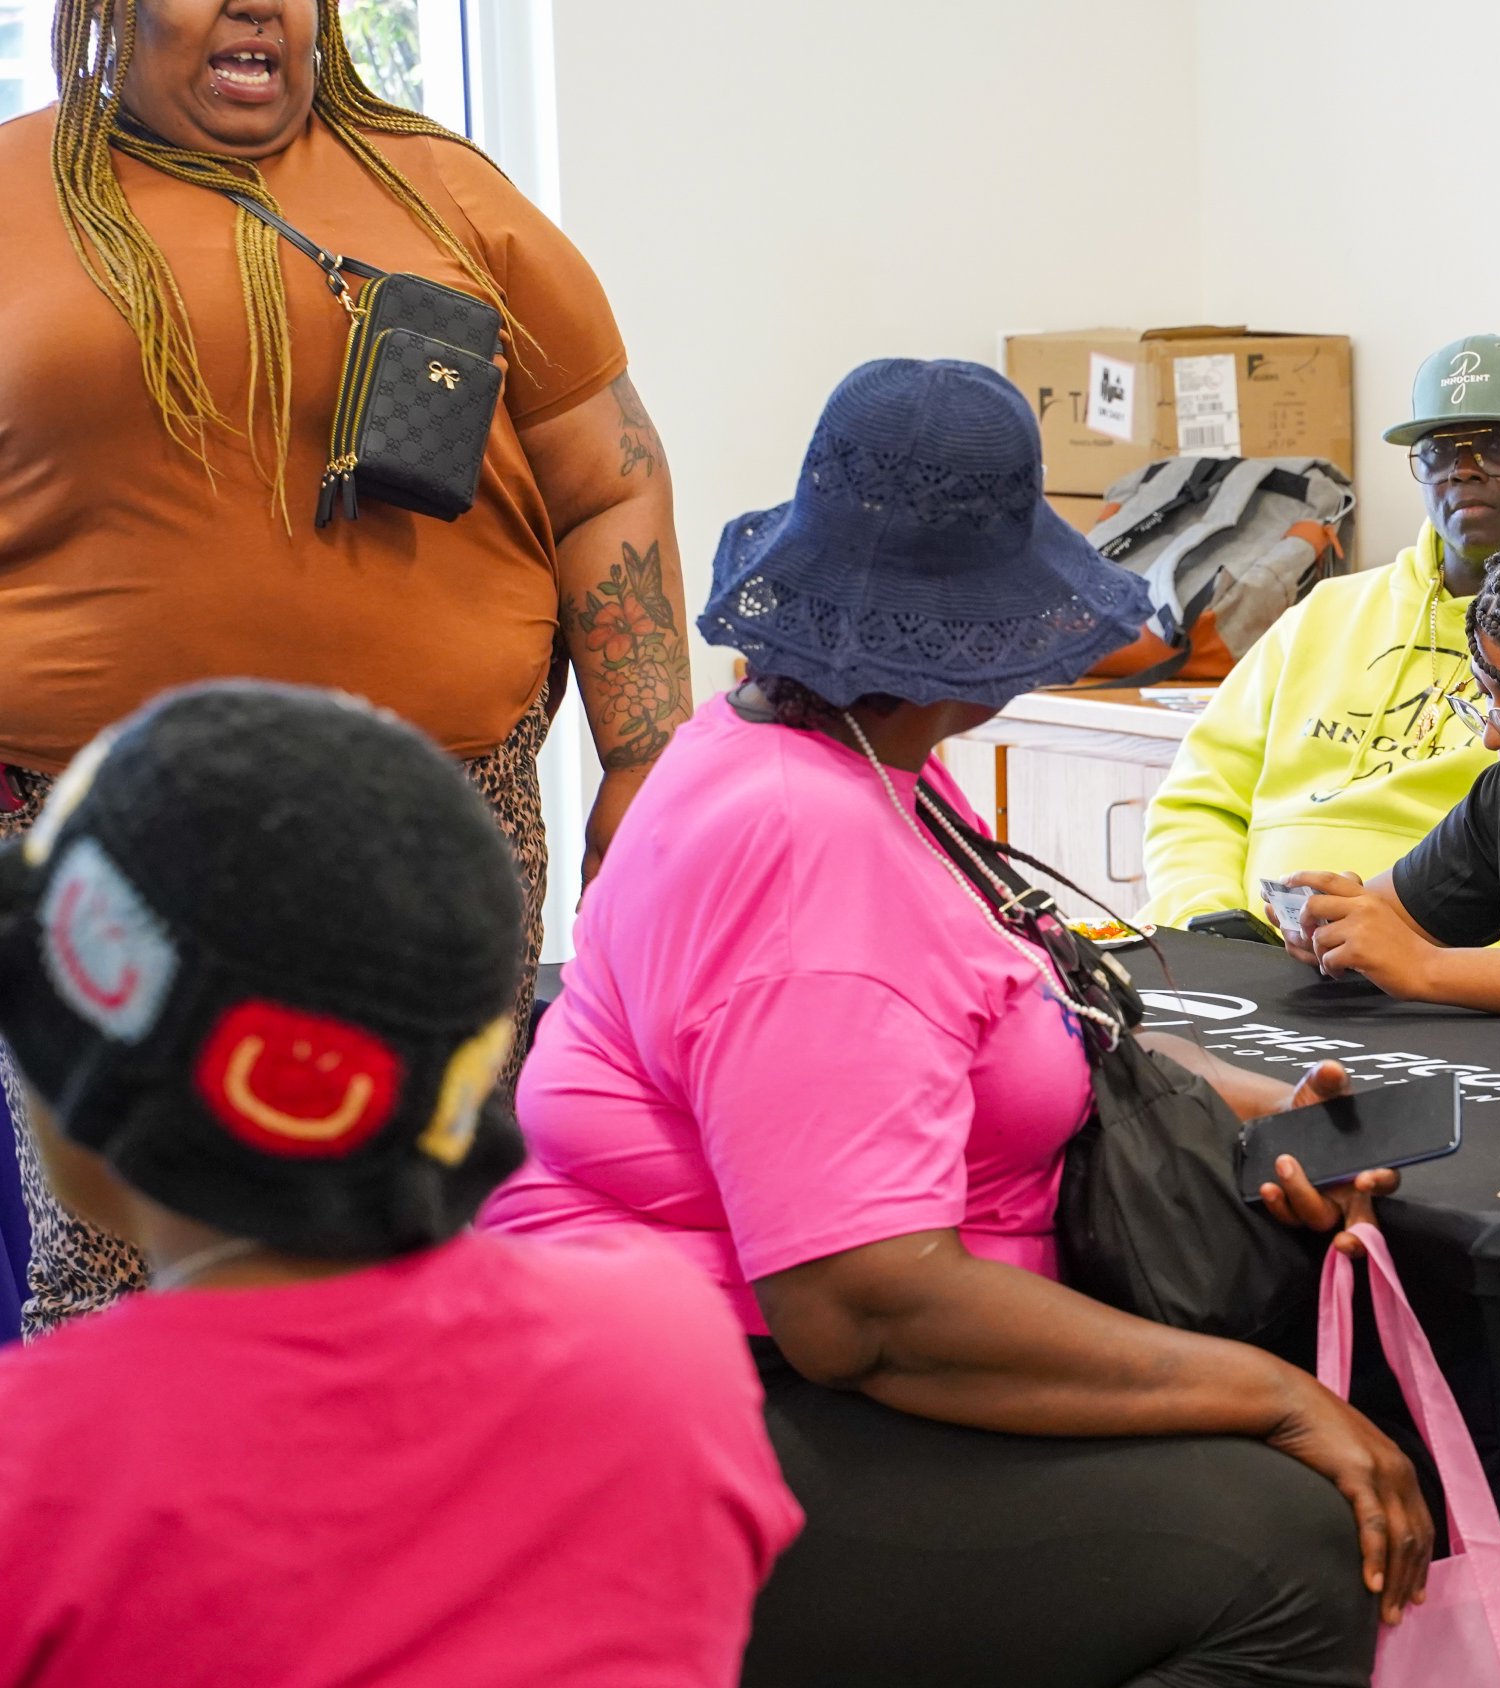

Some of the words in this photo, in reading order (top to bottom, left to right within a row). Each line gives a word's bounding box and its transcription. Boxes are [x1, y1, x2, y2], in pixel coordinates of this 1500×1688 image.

[1441, 374, 1490, 387] INNOCENT
[1302, 718, 1476, 761] INNOCE
[1203, 1023, 1365, 1053] THE
